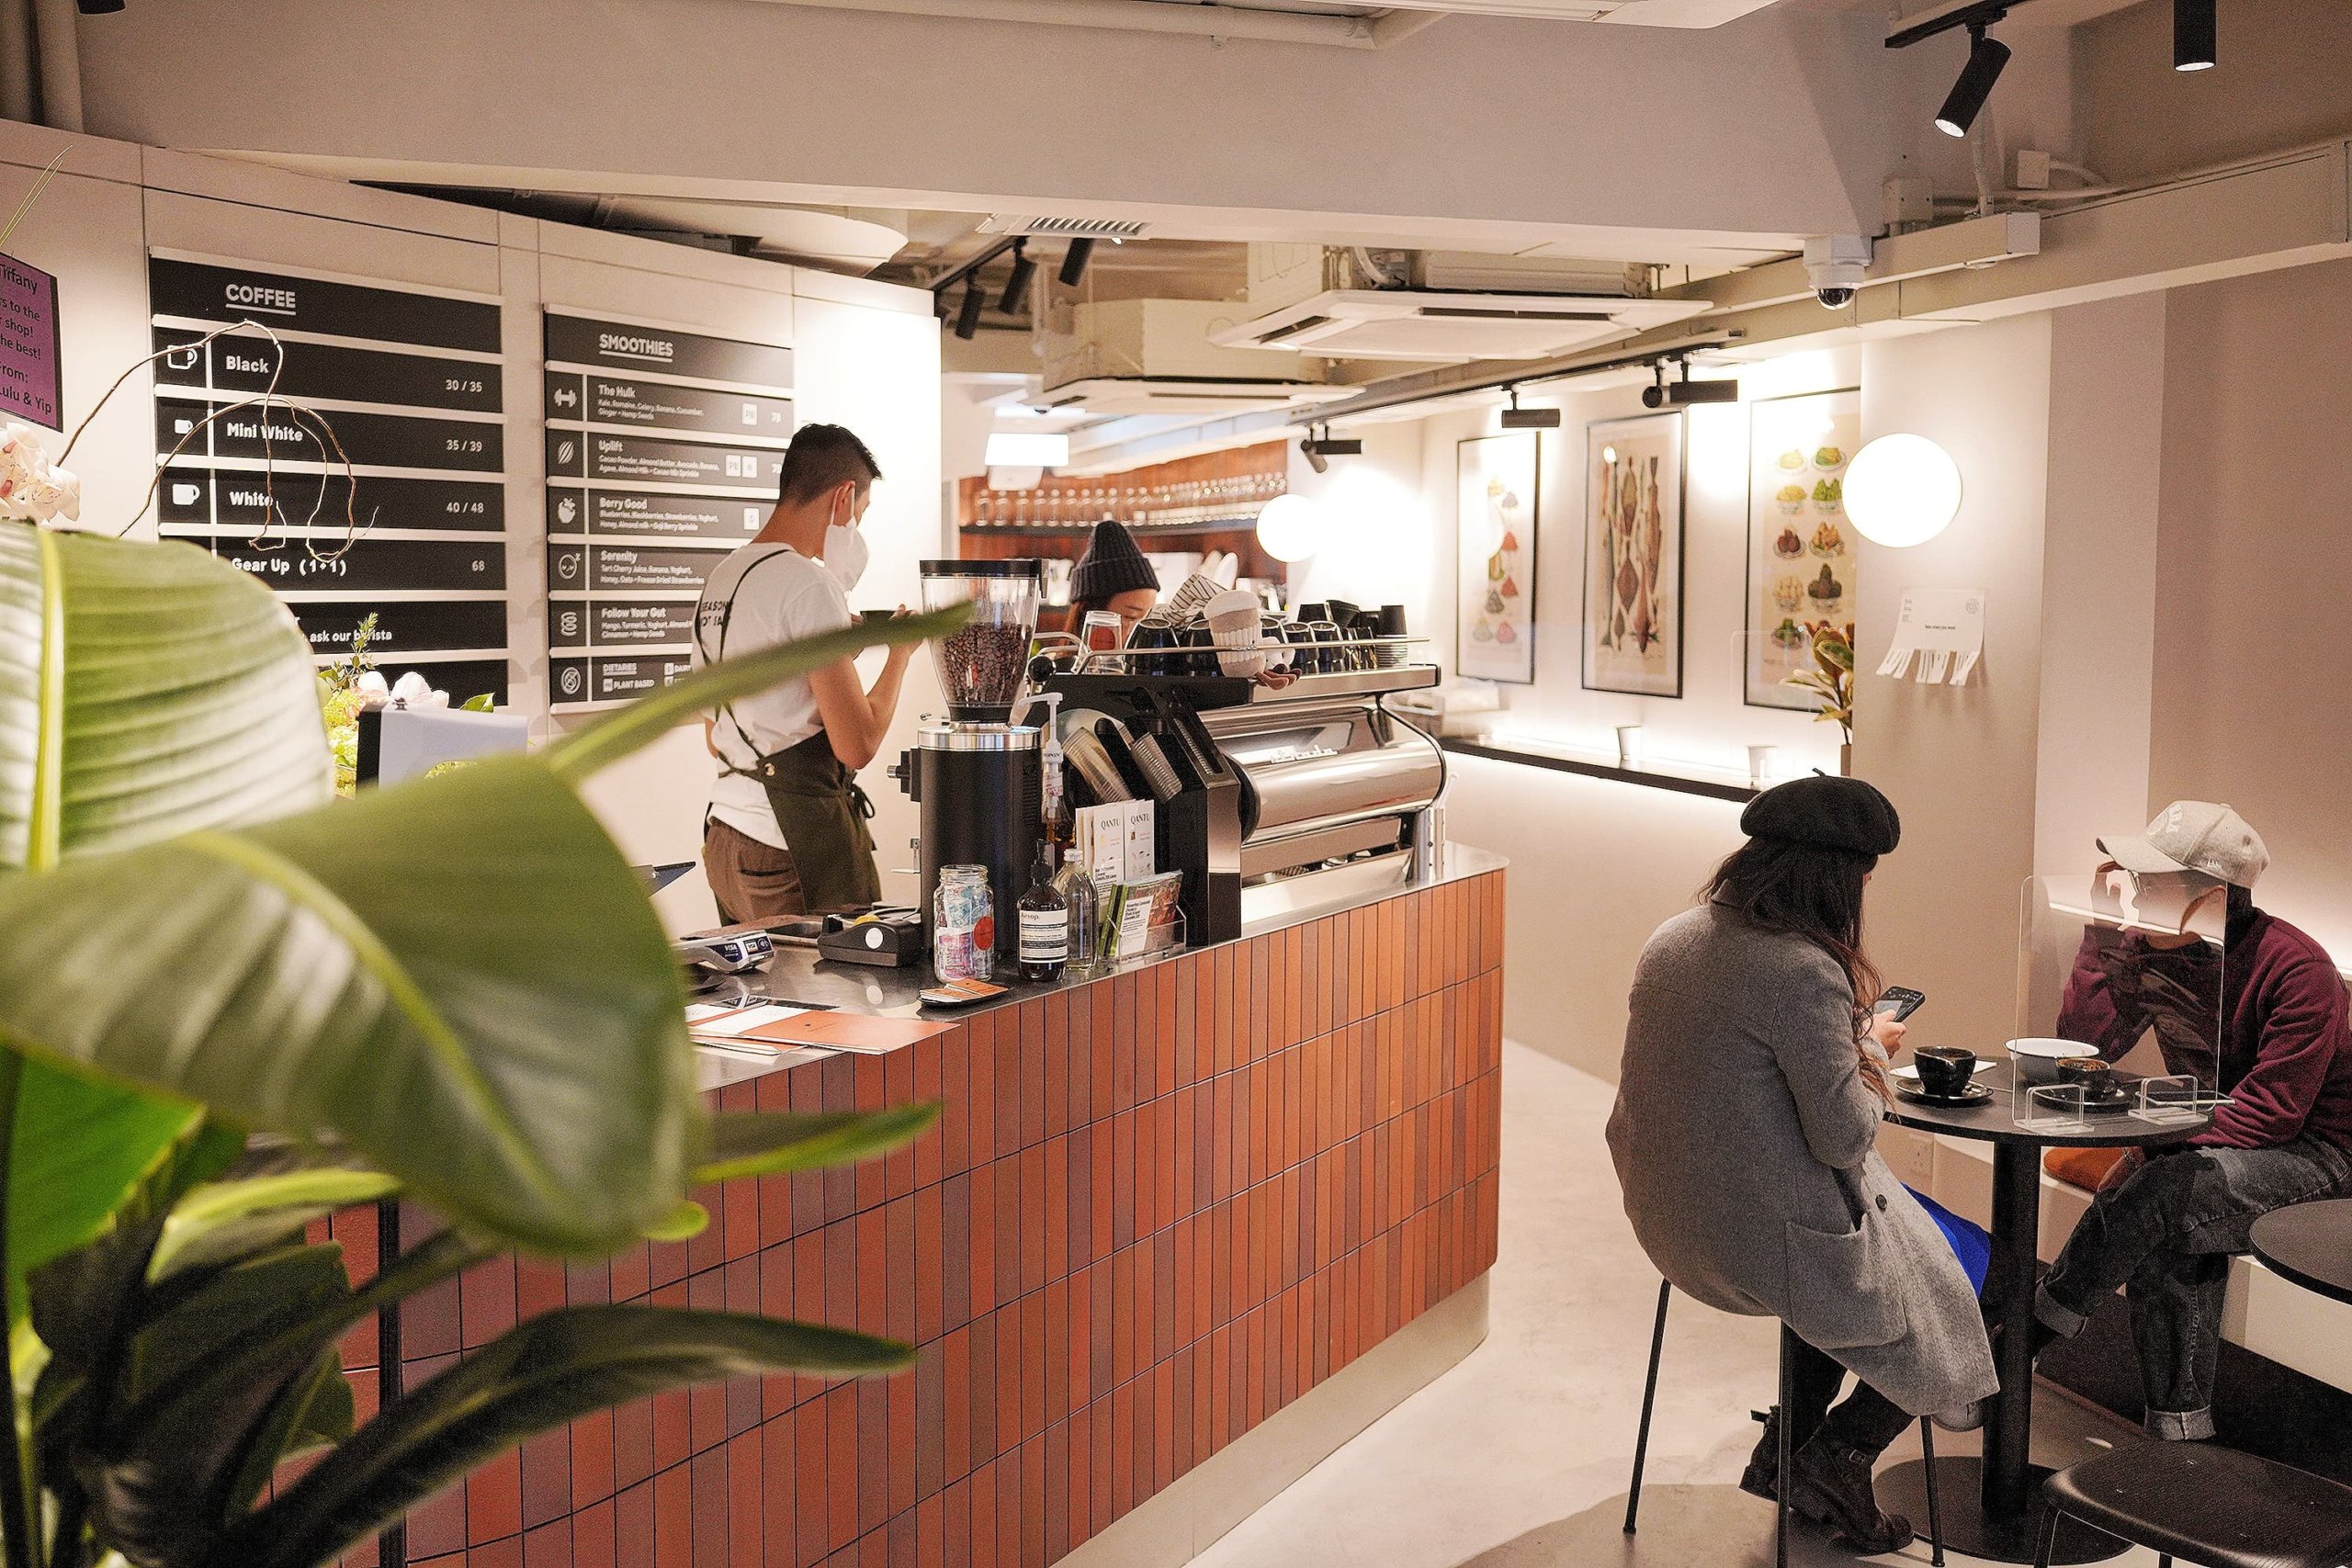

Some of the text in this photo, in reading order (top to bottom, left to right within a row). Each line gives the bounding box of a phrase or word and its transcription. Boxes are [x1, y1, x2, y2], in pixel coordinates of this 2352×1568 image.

[0, 264, 38, 295] iffany
[225, 284, 296, 309] COFFEE
[10, 300, 20, 313] to
[23, 306, 40, 322] the
[5, 318, 33, 338] shop!
[16, 339, 40, 360] best!
[599, 333, 673, 356] SMOOTHIES
[226, 355, 269, 373] Black
[0, 361, 28, 383] rom:
[446, 379, 459, 391] 30
[469, 381, 482, 393] 35
[598, 384, 636, 398] The Hulk
[23, 392, 32, 406] &
[35, 396, 51, 415] Yip
[227, 423, 303, 442] Mini White
[446, 439, 459, 451] 35
[469, 441, 482, 452] 39
[598, 440, 623, 453] Uplift
[446, 502, 460, 513] 40
[470, 502, 484, 513] 48
[599, 497, 648, 511] Berry Good
[600, 549, 638, 564] Serenity
[232, 558, 267, 573] Gear
[271, 558, 290, 575] Up
[471, 560, 485, 572] 68
[602, 607, 666, 618] Follow Your Gut
[310, 630, 330, 643] ask
[332, 631, 352, 642] our
[603, 662, 638, 672] DIETARIES
[614, 681, 634, 690] PLANT
[634, 679, 655, 689] BASED
[1102, 818, 1120, 830] QANTU
[1131, 813, 1150, 825] QANTU
